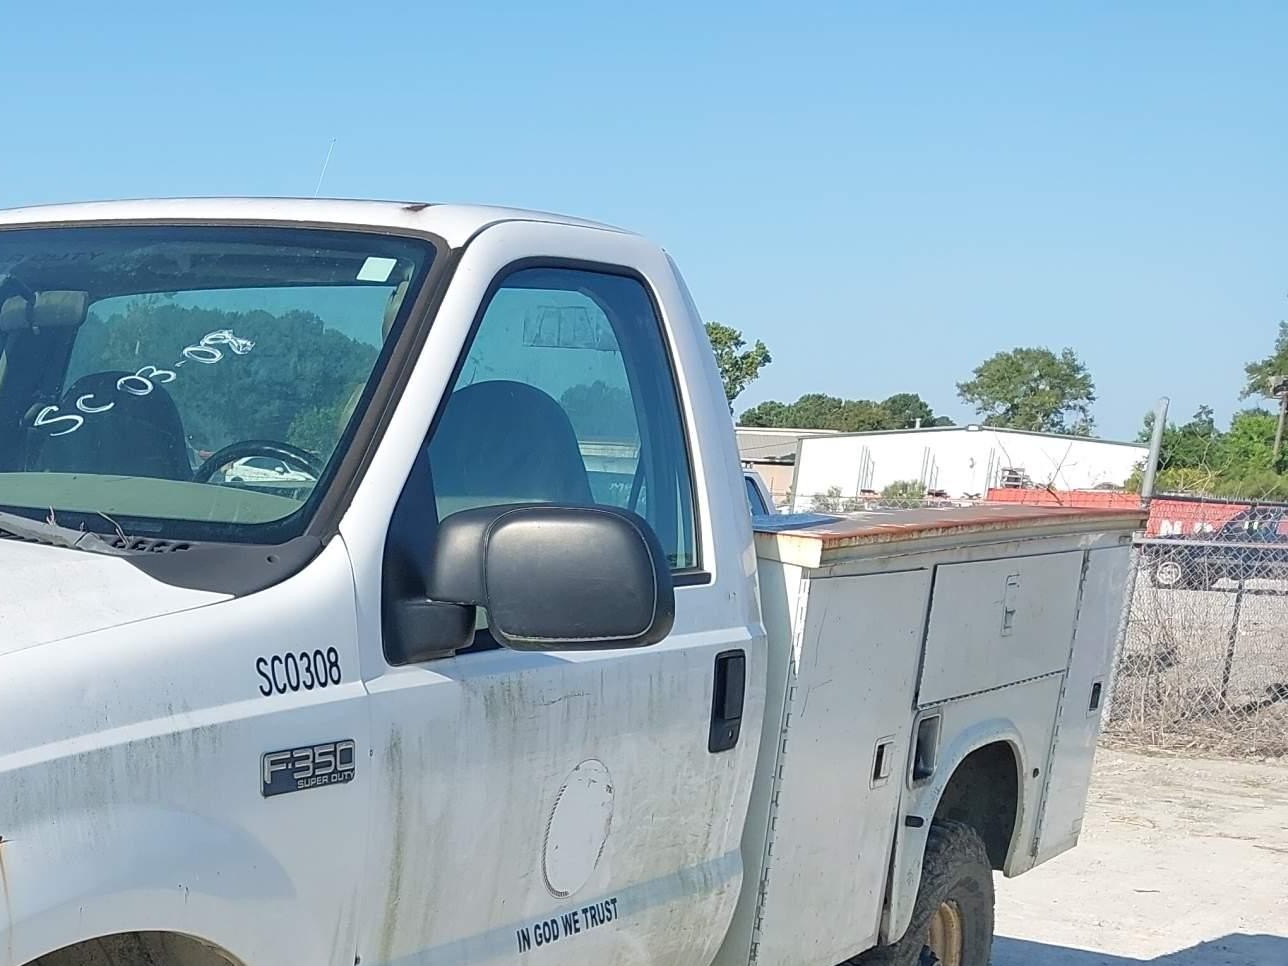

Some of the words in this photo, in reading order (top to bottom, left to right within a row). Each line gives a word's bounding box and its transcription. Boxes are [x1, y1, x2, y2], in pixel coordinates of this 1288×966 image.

[255, 646, 342, 697] SC0308
[297, 774, 329, 788] SUPER
[331, 770, 355, 782] DUTY
[516, 927, 531, 953] IN
[533, 918, 560, 947] GOD
[560, 911, 581, 937] WE
[580, 897, 618, 929] TRUST
